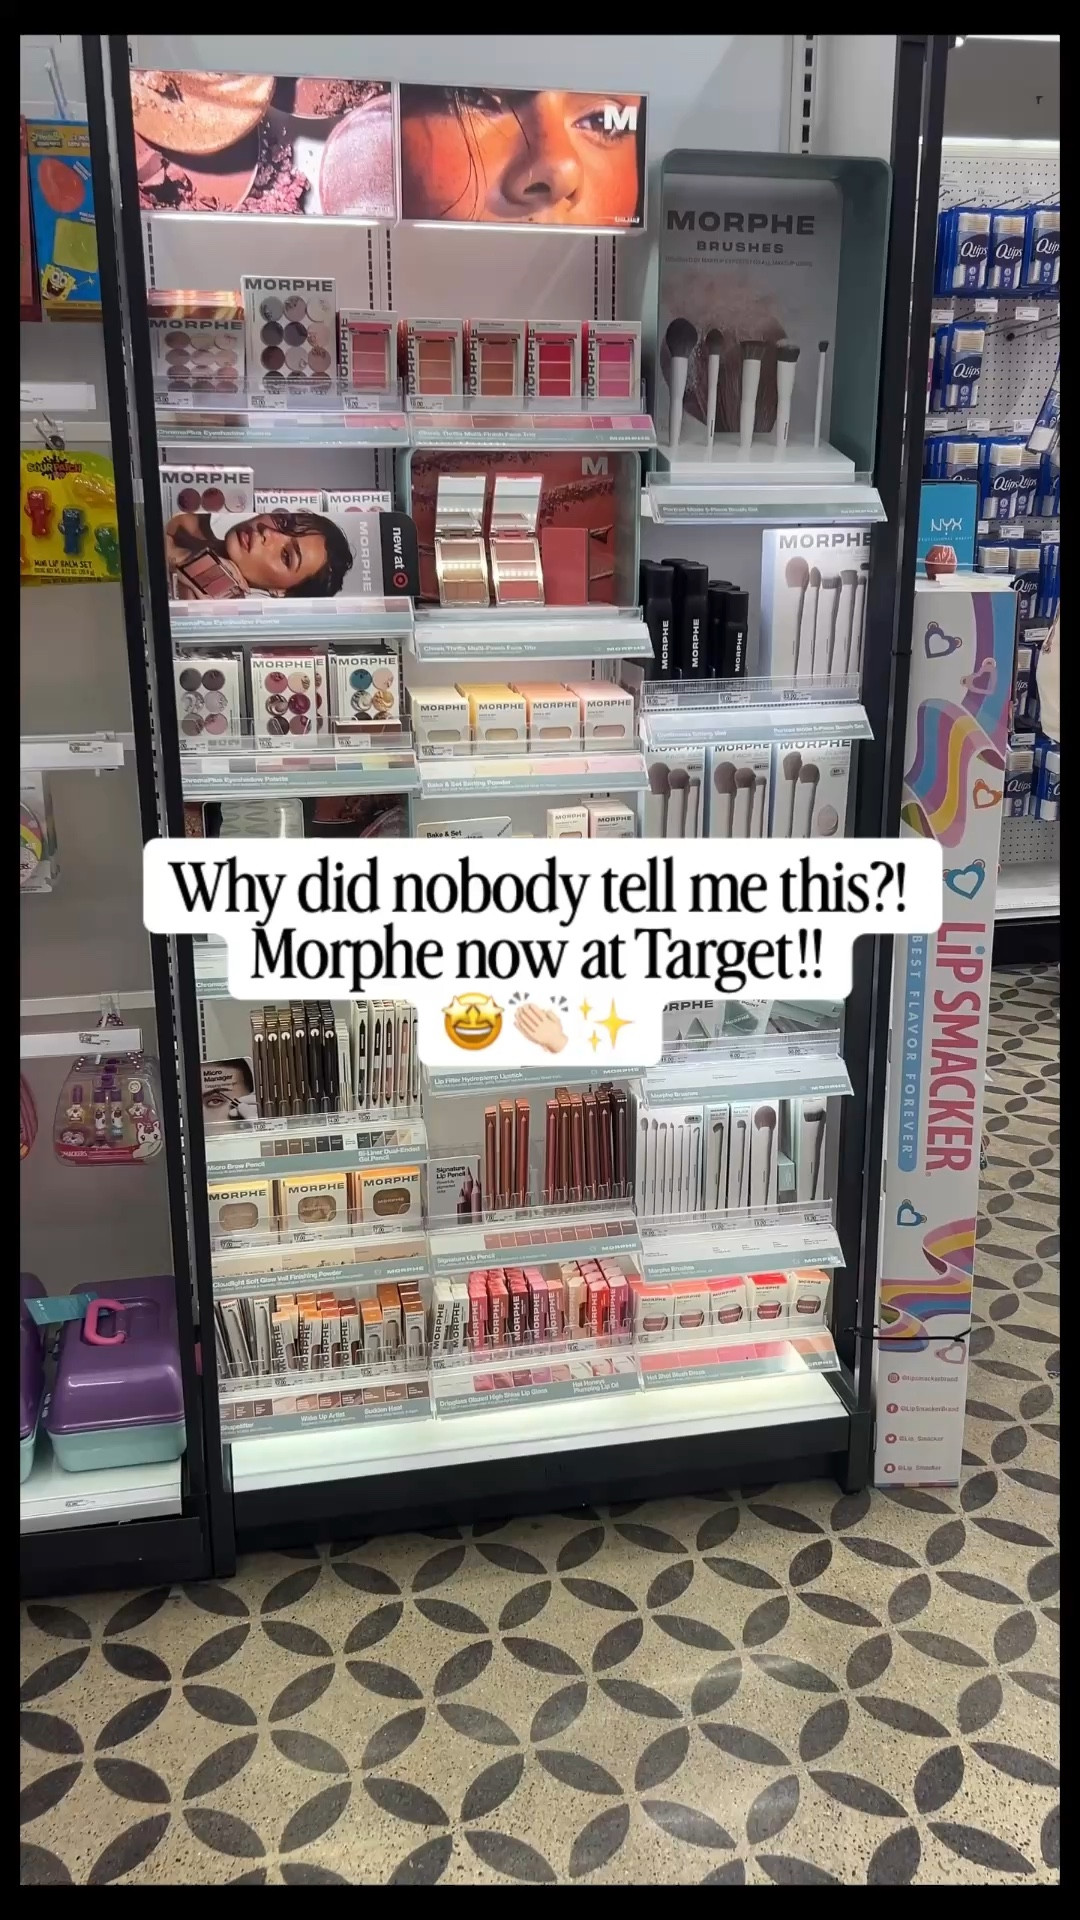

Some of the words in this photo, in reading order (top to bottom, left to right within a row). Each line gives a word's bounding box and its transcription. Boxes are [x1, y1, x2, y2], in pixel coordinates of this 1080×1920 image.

[603, 105, 637, 131] M
[667, 210, 815, 235] MORPHE
[697, 240, 784, 254] BRUSHES
[245, 278, 333, 292] MORPHE
[149, 319, 243, 330] MORPHE
[408, 326, 416, 396] MORPHE
[470, 328, 478, 398] MORPHE
[528, 329, 536, 398] MORPHE
[588, 329, 596, 400] MORPHE
[581, 457, 608, 475] M
[162, 473, 250, 484] MORPHE
[257, 495, 318, 504] MORPHE
[330, 494, 390, 503] MORPHE
[931, 518, 962, 532] NYX
[393, 527, 402, 550] new
[780, 532, 872, 549] MORPHE
[359, 522, 372, 592] MORPHE
[394, 553, 404, 569] at
[692, 618, 700, 668] MORPHE
[734, 632, 743, 672] MORPHE
[253, 660, 313, 669] MORPHE
[338, 658, 396, 666] MORPHE
[420, 704, 467, 712] MORPHE
[478, 703, 524, 711] MORPHE
[587, 700, 631, 708] MORPHE
[715, 743, 770, 752] MORPHE
[779, 740, 850, 749] MORPHE
[910, 935, 922, 978] BEST
[663, 1000, 713, 1011] RPHE
[906, 991, 920, 1061] FLAVOR
[204, 1074, 233, 1082] Manager
[245, 1161, 265, 1169] Pencil
[288, 1182, 345, 1193] MORPHE
[363, 1175, 419, 1186] MORPHE
[209, 1190, 266, 1200] MORPHE
[602, 1243, 637, 1251] MORPHE
[437, 1255, 465, 1264] Signature
[466, 1255, 476, 1263] Lip
[804, 1255, 839, 1264] MORPHE
[386, 1266, 424, 1274] MORPHE
[212, 1279, 245, 1288] Cloudlight
[290, 1272, 317, 1281] Finishing
[318, 1269, 343, 1277] Powder
[492, 1297, 500, 1343] MORPHE
[549, 1292, 558, 1337] MORPHE
[433, 1304, 445, 1350] MORPHE
[274, 1324, 287, 1373] MORPHE
[301, 1323, 310, 1371] MORPHE
[318, 1414, 328, 1422] Up
[329, 1412, 345, 1420] Artist
